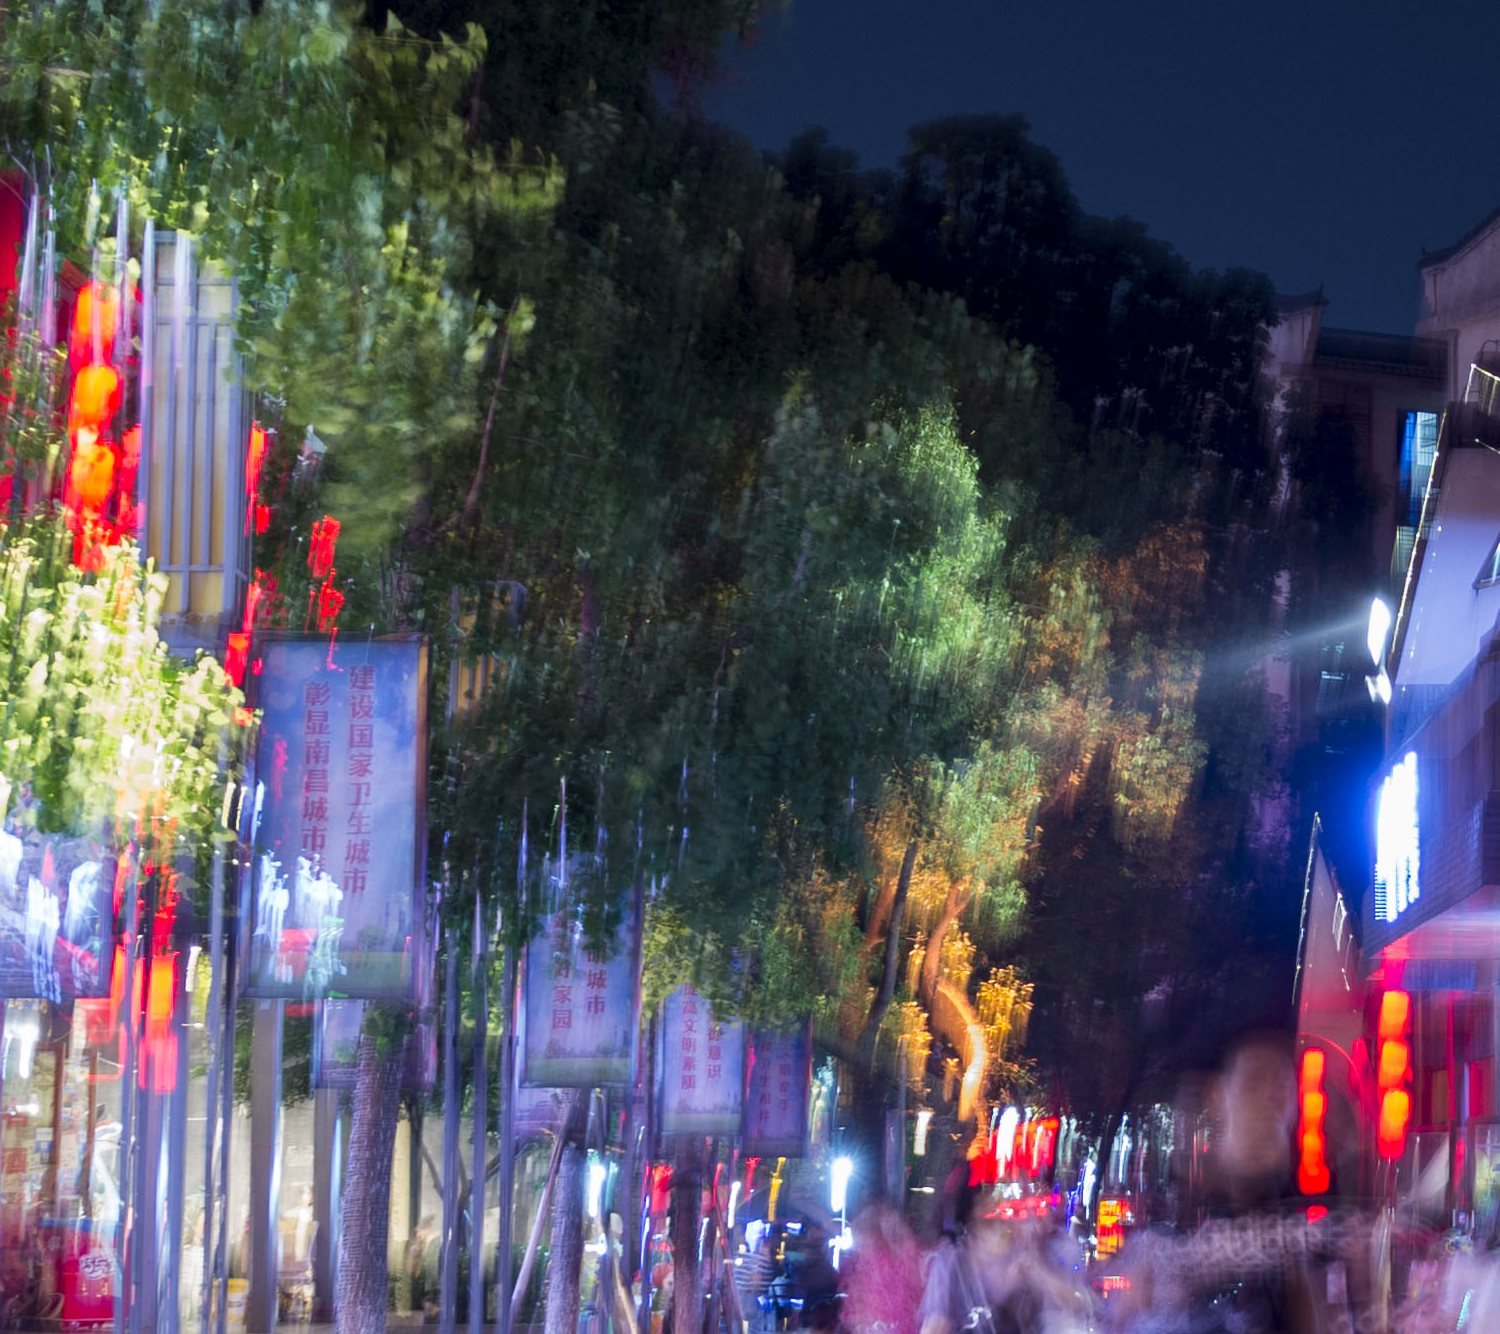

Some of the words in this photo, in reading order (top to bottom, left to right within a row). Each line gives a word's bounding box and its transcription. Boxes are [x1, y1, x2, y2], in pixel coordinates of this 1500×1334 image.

[343, 664, 375, 894] 建设国家卫生城市
